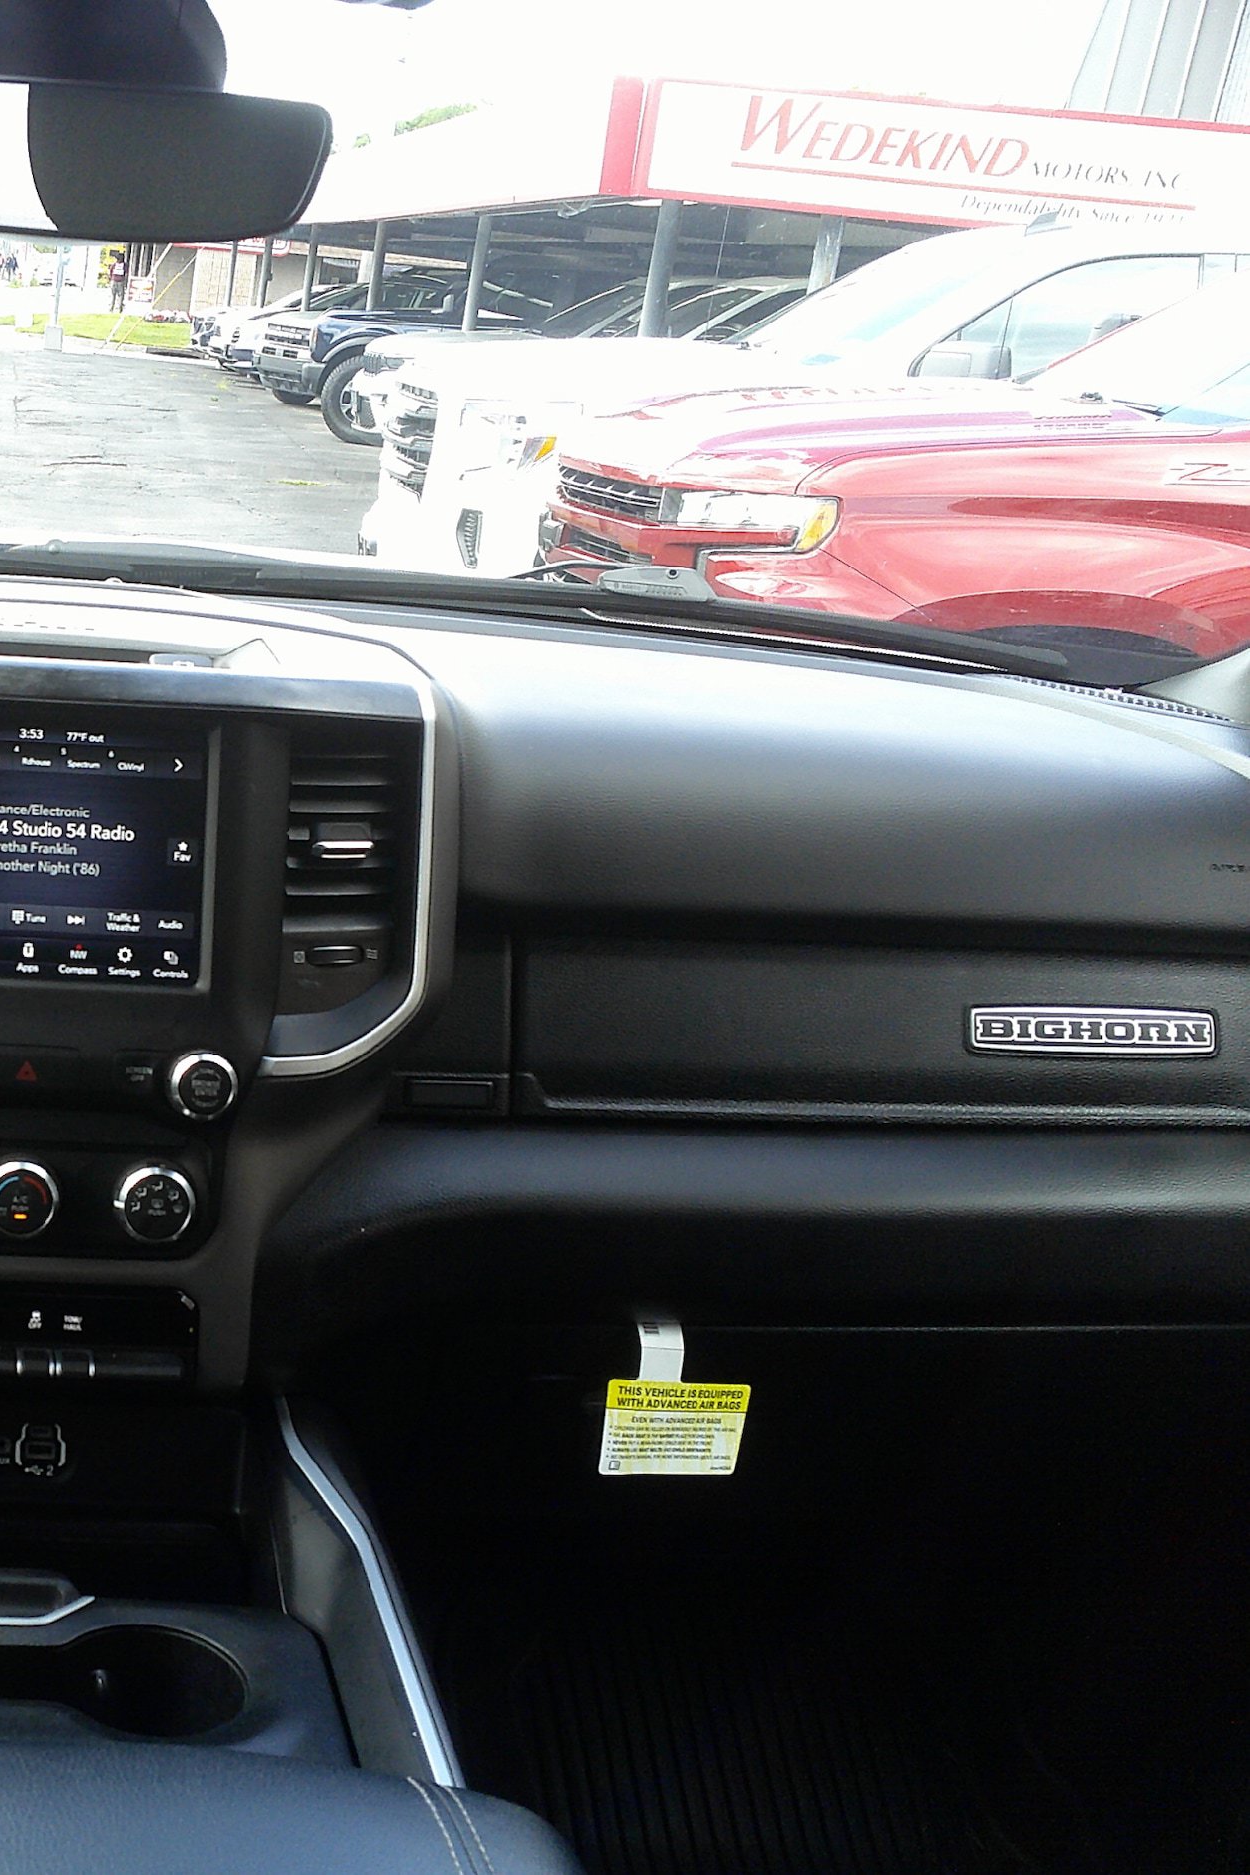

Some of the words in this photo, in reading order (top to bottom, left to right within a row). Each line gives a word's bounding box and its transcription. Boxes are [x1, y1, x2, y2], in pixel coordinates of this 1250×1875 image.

[740, 95, 1030, 177] WEDEKIND
[1092, 207, 1134, 223] Since
[19, 728, 45, 740] 3:53
[88, 734, 104, 744] out
[13, 745, 20, 753] 4
[67, 760, 101, 769] Spectrum
[12, 820, 63, 838] Studio
[65, 823, 86, 839] 54
[90, 824, 136, 842] Radio
[30, 842, 78, 856] Franklin
[173, 851, 193, 862] Fav
[37, 861, 70, 877] Night
[25, 912, 47, 924] Tune
[106, 911, 131, 922] Traffic
[132, 913, 141, 923] &
[105, 922, 141, 933] Weather
[157, 919, 184, 930] Audio
[69, 949, 88, 960] NW
[15, 961, 40, 974] Apps
[57, 963, 99, 976] Compass
[107, 966, 141, 978] Settings
[152, 967, 190, 980] Controls
[977, 1017, 1212, 1044] BIGHORN
[617, 1385, 642, 1396] THIS
[644, 1387, 687, 1399] VEHICLE
[687, 1389, 697, 1398] IS
[698, 1389, 744, 1399] EQUIPPED
[617, 1397, 644, 1407] WITH
[646, 1399, 697, 1409] ADVANCED
[699, 1401, 715, 1410] AIR
[716, 1402, 741, 1410] BAGS
[631, 1416, 648, 1424] EVEN
[46, 1465, 55, 1477] 2
